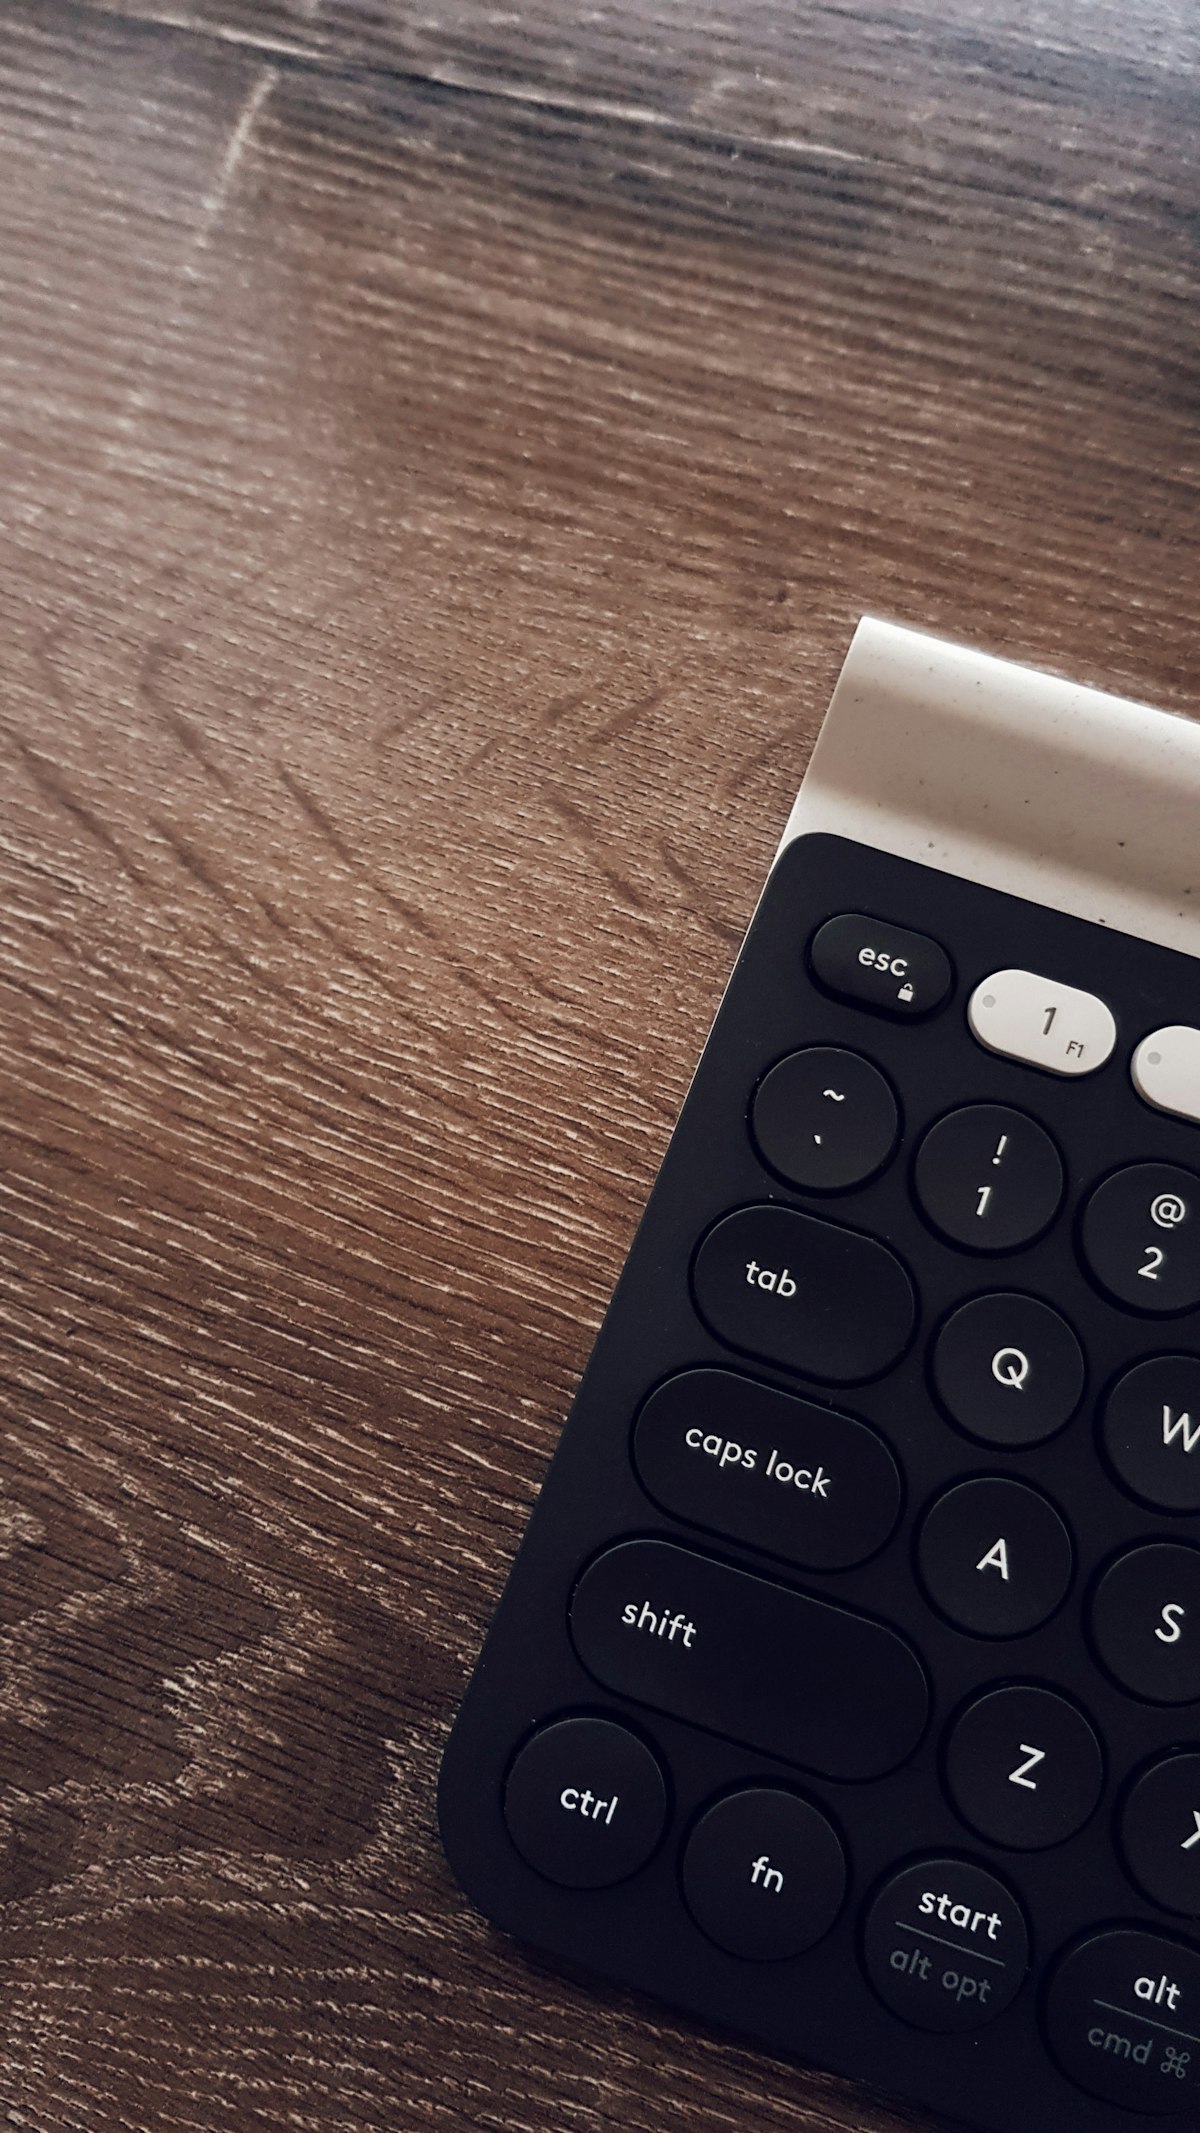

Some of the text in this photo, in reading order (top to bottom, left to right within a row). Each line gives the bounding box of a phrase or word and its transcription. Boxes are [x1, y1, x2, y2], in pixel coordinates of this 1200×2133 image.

[858, 947, 908, 977] esc
[1043, 1006, 1058, 1036] 1
[1065, 1039, 1086, 1060] F1
[992, 1134, 1008, 1166] !
[976, 1186, 992, 1216] 1
[1150, 1193, 1186, 1229] @
[745, 1260, 797, 1297] tab
[1137, 1246, 1164, 1280] 2
[991, 1347, 1030, 1391] Q
[1162, 1404, 1200, 1453] W
[685, 1428, 831, 1498] caps lock
[975, 1538, 1010, 1580] A
[621, 1600, 697, 1648] shift
[1154, 1603, 1185, 1643] S
[1008, 1743, 1046, 1790] Z
[560, 1787, 619, 1825] ctrl
[750, 1856, 784, 1893] fn
[918, 1892, 1002, 1941] start
[889, 1949, 991, 2003] alt opt
[1134, 1975, 1181, 2010] alt
[1088, 2028, 1153, 2065] cmd
